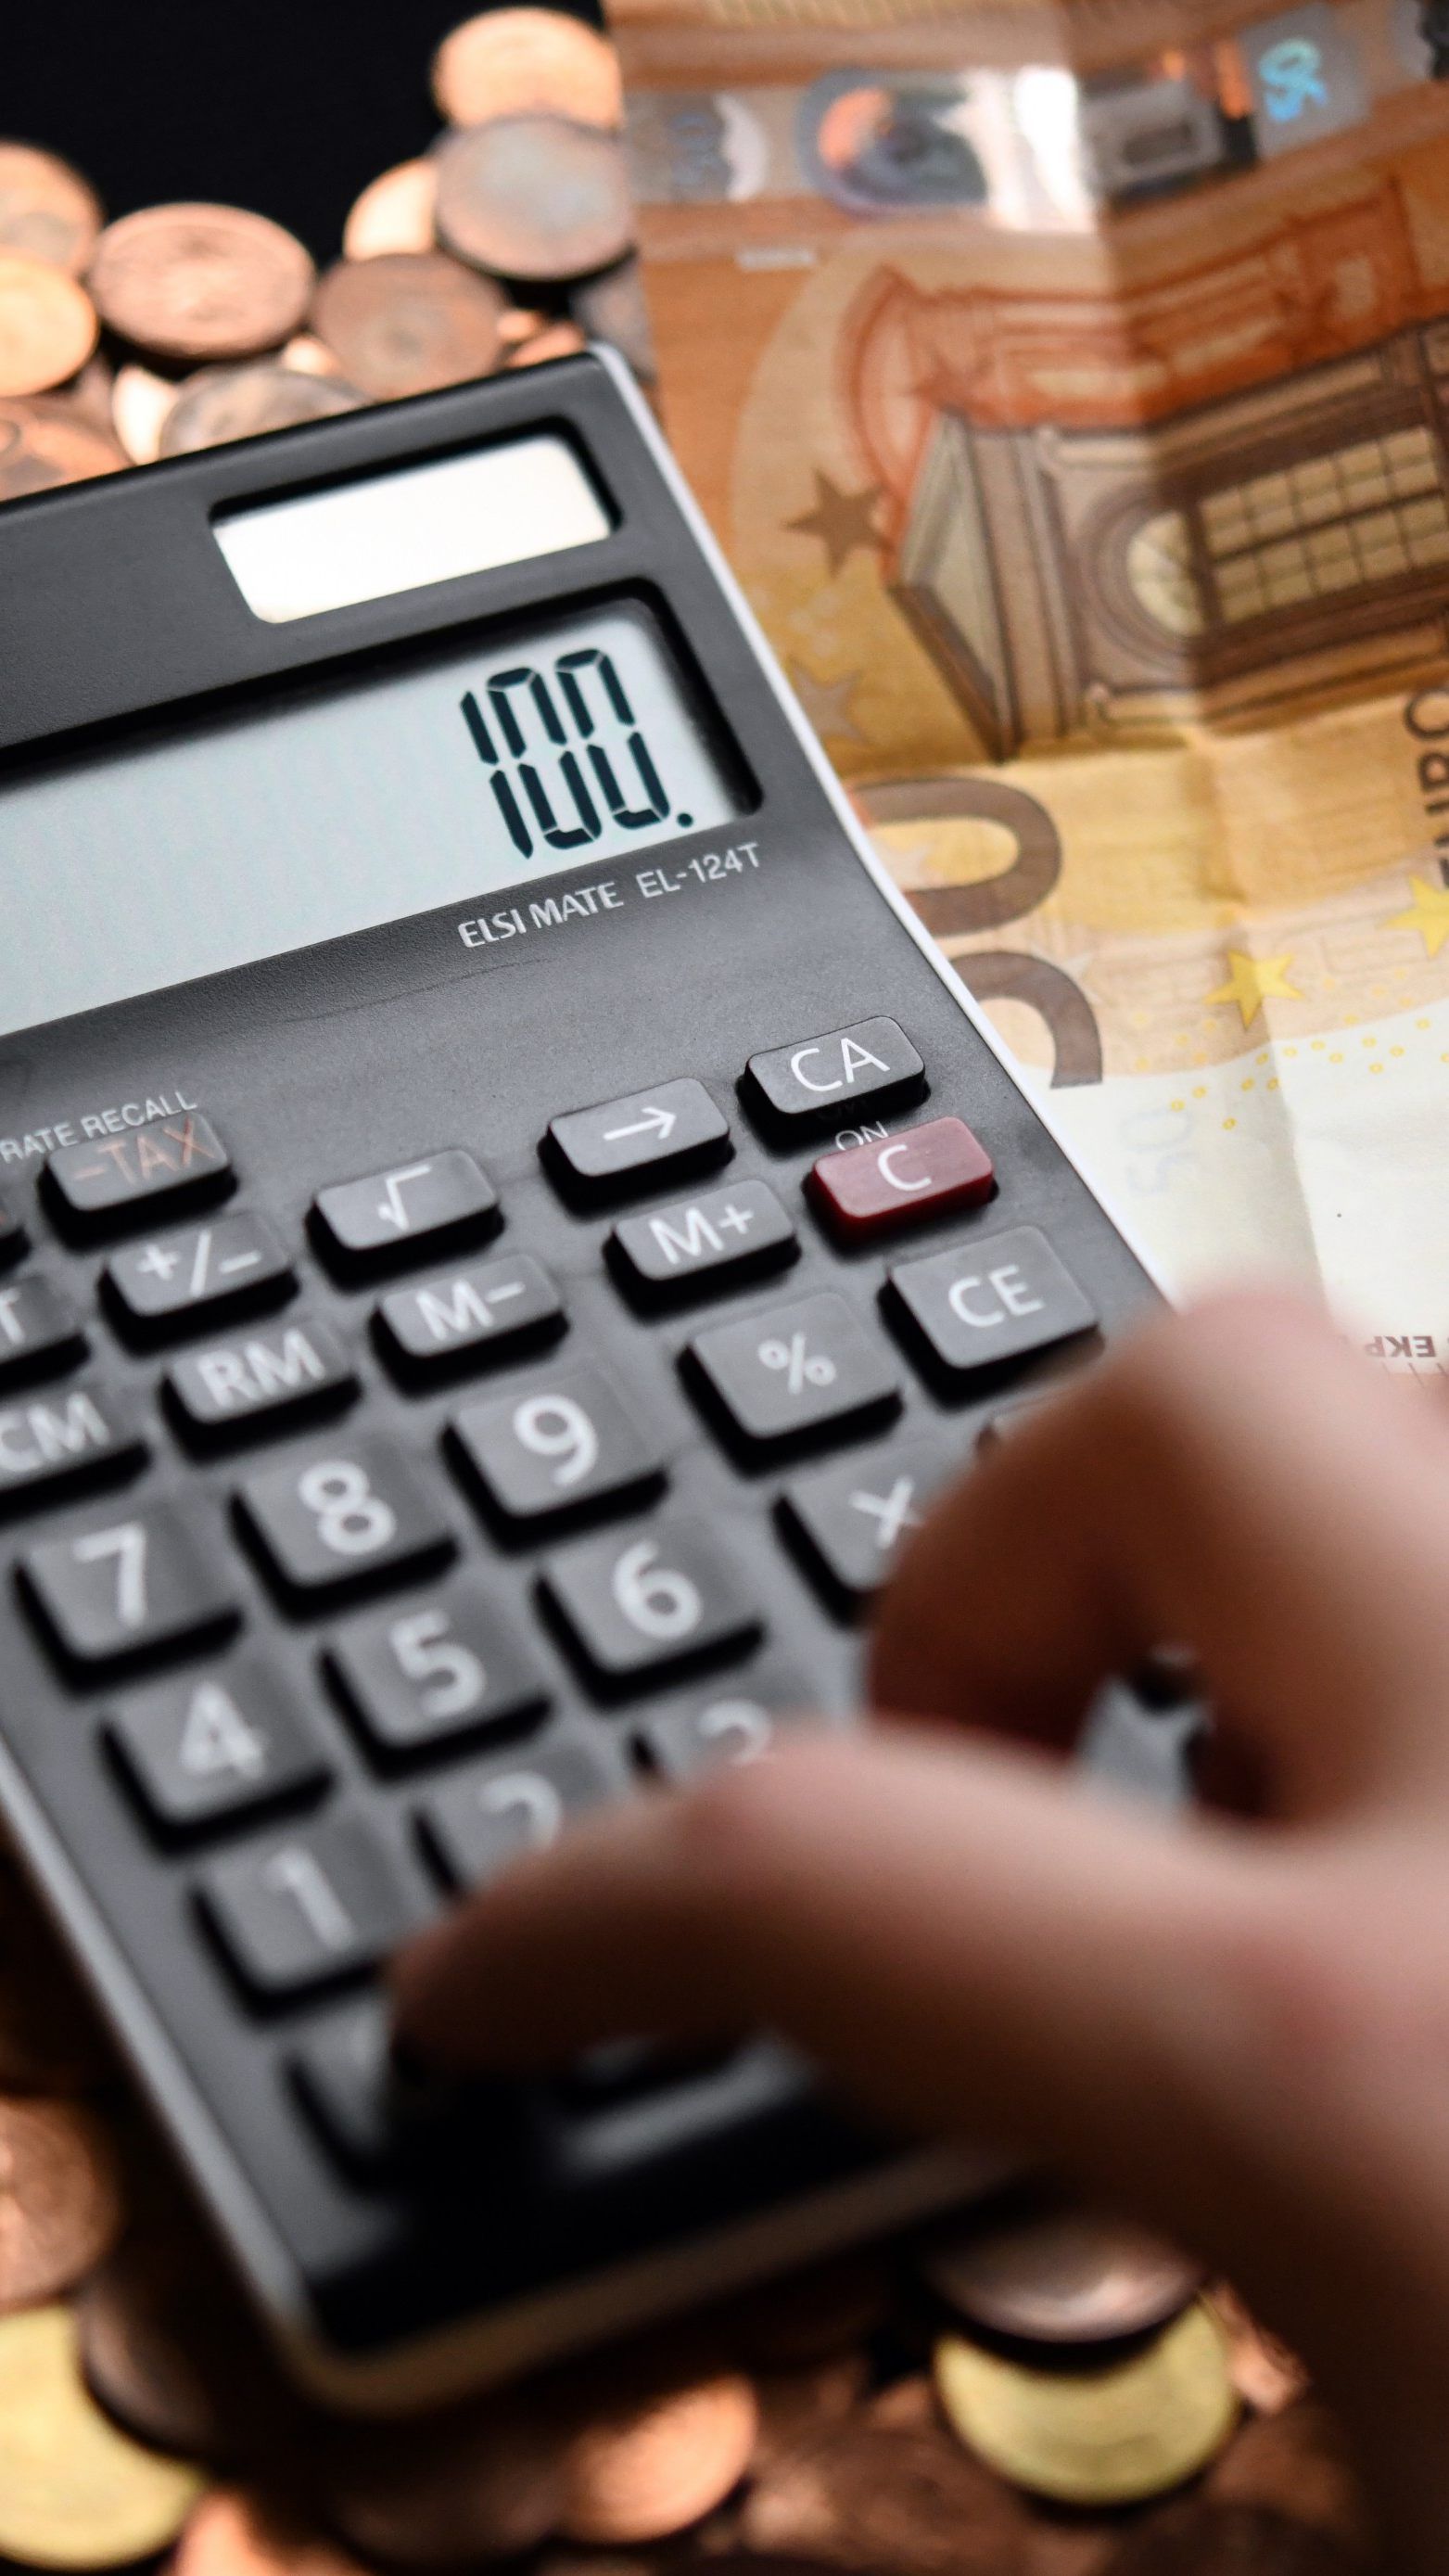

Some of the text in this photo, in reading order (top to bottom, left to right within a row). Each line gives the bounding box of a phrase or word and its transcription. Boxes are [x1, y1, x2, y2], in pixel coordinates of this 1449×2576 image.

[459, 648, 693, 860] 100.
[529, 882, 624, 930] MATE
[636, 842, 760, 899] EL-124T
[790, 1037, 890, 1092] CA
[0, 1090, 197, 1164] RATE RECALL
[835, 1119, 889, 1151] ON
[877, 1144, 932, 1192] C
[649, 1205, 754, 1265] M+
[415, 1281, 525, 1341] M-
[947, 1265, 1045, 1329] CE
[197, 1328, 326, 1407] RM
[757, 1332, 836, 1396] %
[1365, 1335, 1436, 1358] EKP
[513, 1395, 600, 1486] 9
[298, 1460, 397, 1558] 8
[71, 1522, 147, 1626] 7
[612, 1538, 704, 1639] 6
[388, 1608, 487, 1719] 5
[177, 1679, 268, 1780] 4
[263, 1847, 356, 1949] 1
